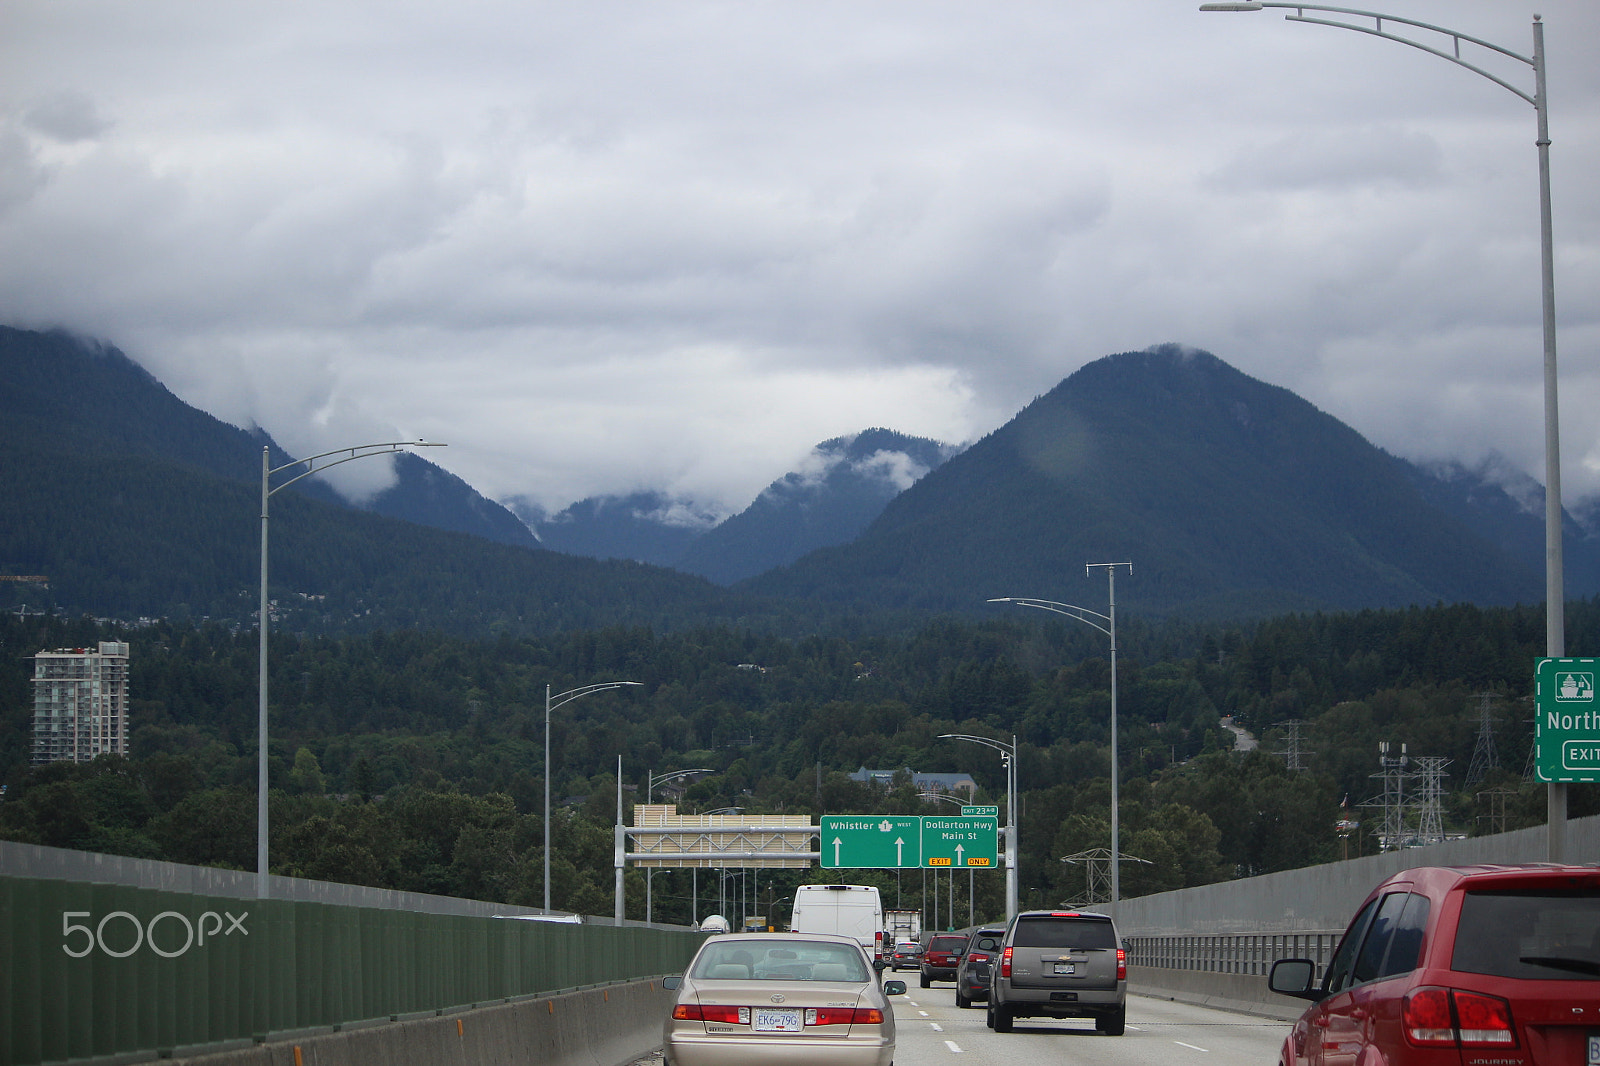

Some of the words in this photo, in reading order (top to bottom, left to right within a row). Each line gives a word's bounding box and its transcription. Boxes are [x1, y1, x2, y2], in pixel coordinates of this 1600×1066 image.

[1547, 711, 1600, 730] North
[1570, 748, 1600, 760] EXIT
[829, 821, 874, 830] Whistler
[925, 821, 970, 829] Dollarton
[973, 821, 993, 831] Hwy
[941, 831, 964, 840] Main
[967, 832, 977, 840] St
